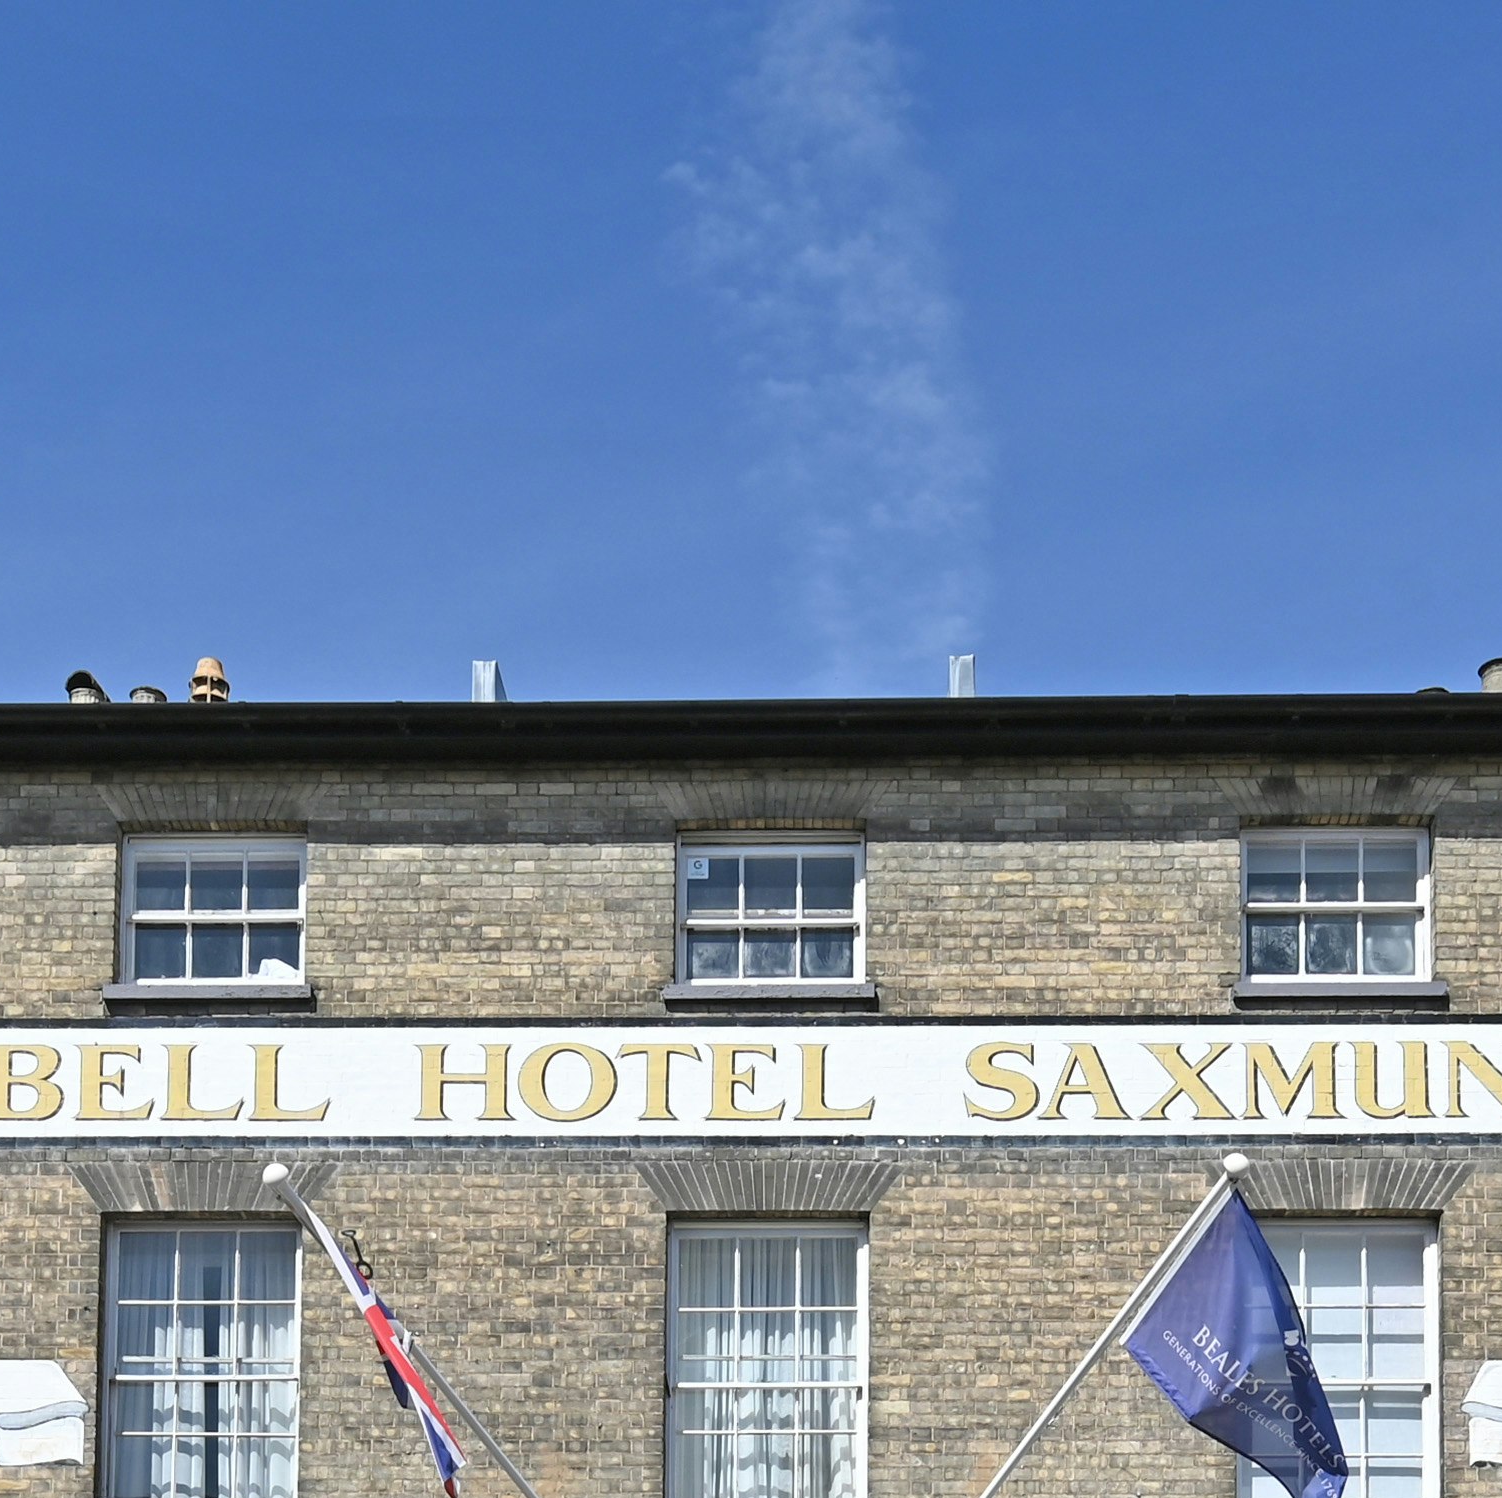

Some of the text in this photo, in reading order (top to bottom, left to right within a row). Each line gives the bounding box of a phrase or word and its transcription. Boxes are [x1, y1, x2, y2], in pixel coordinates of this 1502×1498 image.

[414, 1043, 876, 1122] HOTEL
[1162, 1330, 1222, 1396] GENERATIONS
[1220, 1392, 1237, 1405] OF
[1235, 1401, 1298, 1448] EXCELLENCE
[1296, 1447, 1325, 1478] SINCE
[1192, 1323, 1345, 1469] BEALES HOTELS
